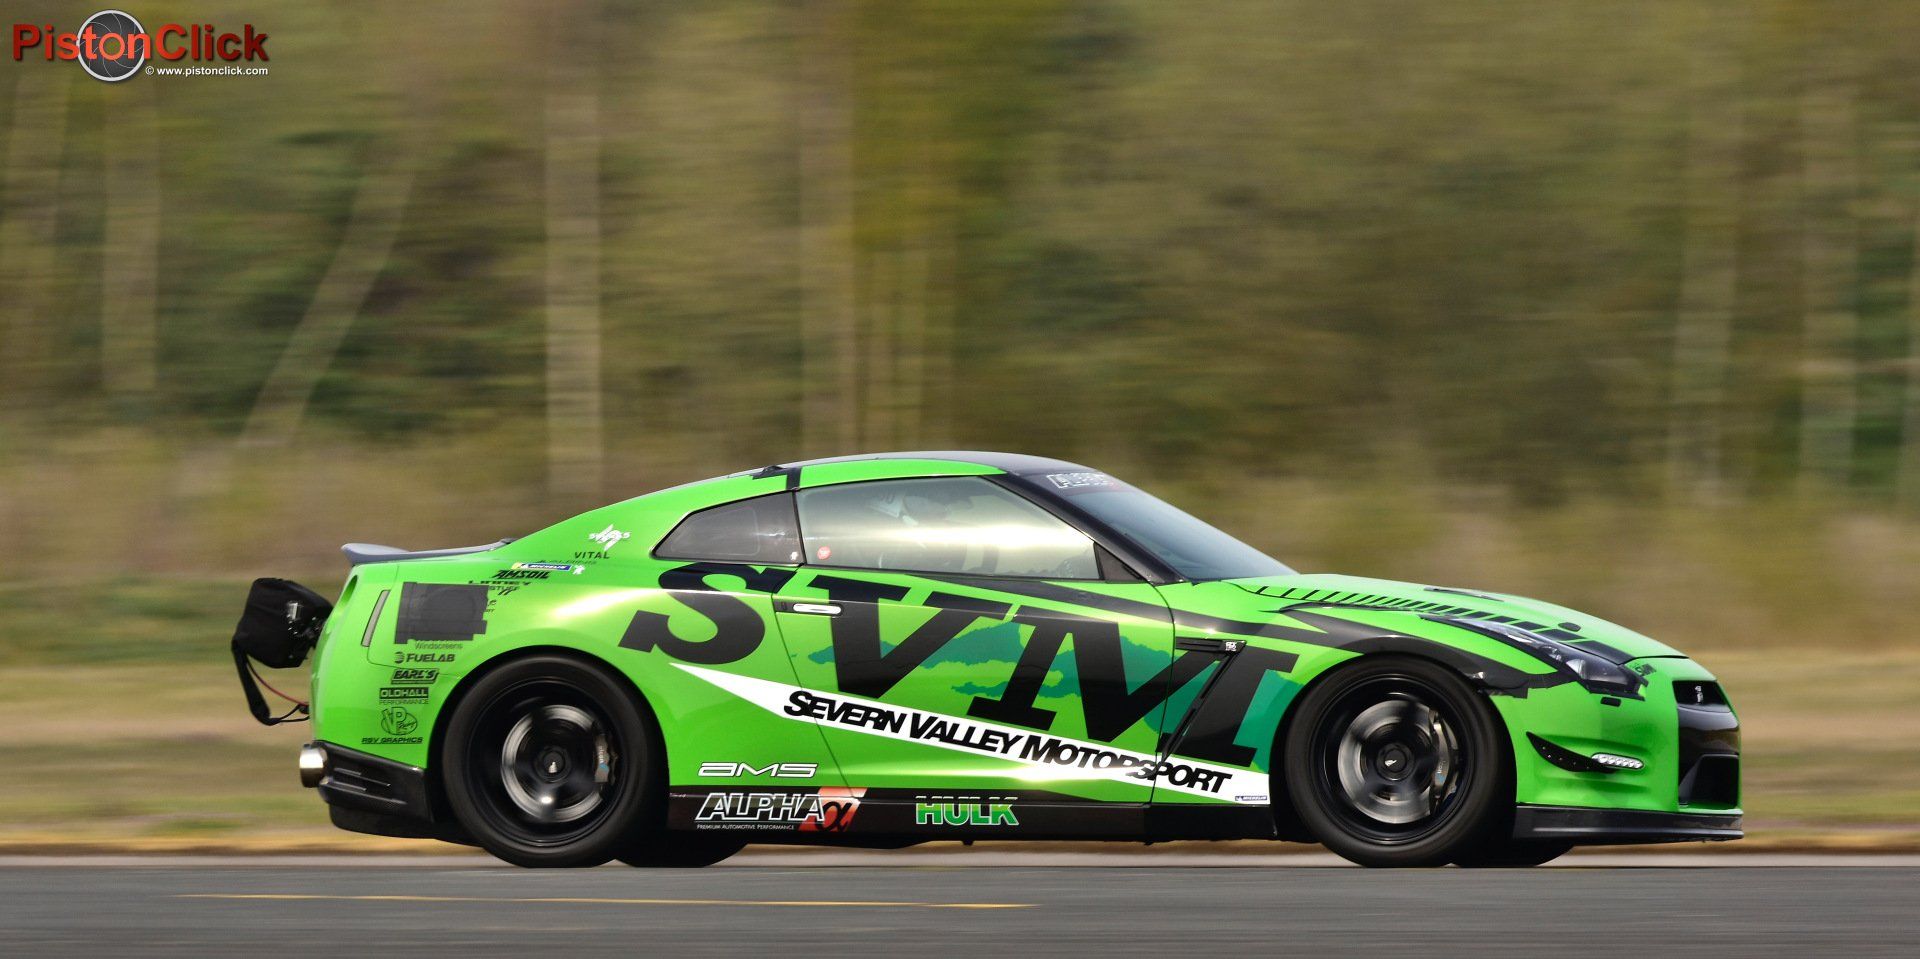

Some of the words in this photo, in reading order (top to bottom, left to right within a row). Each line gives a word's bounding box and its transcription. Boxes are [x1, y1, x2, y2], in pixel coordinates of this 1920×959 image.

[574, 551, 610, 559] VITAL
[491, 569, 551, 579] AMSOIL
[406, 653, 455, 662] FUELAB
[618, 561, 1300, 767] SVM
[393, 669, 437, 680] EARL'S
[381, 689, 428, 697] OLDHALL
[782, 690, 908, 734] SEVERN
[907, 713, 1025, 754] VALLEY
[1018, 735, 1234, 793] MOTORSPORT
[695, 792, 826, 822] ALPHA
[915, 796, 1020, 826] HULK
